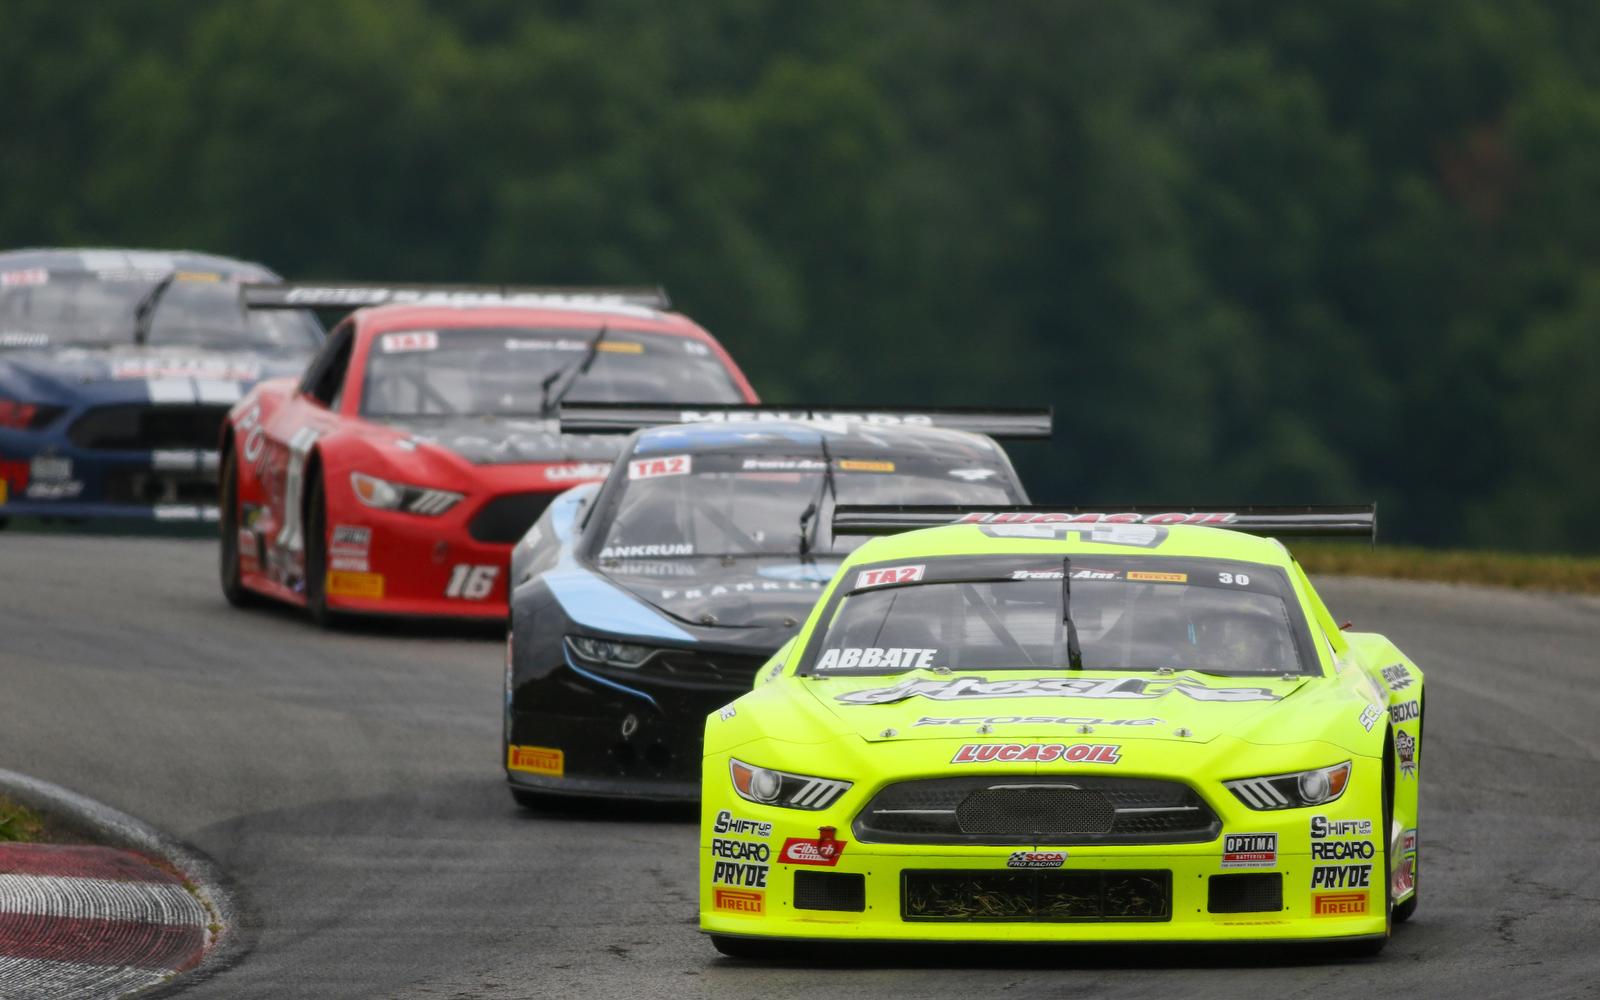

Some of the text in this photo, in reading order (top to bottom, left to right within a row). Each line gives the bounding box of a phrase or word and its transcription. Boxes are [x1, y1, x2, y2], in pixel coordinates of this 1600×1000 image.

[635, 458, 684, 476] TA2
[600, 544, 693, 558] ANKRUM
[445, 564, 499, 598] 16
[865, 566, 918, 585] TA2
[1218, 572, 1249, 586] 30
[660, 581, 820, 599] FRANKLI
[815, 647, 938, 670] ABBATE
[951, 743, 1122, 764] LUCAS OIL
[714, 811, 772, 835] SHIFT UP
[1311, 816, 1371, 838] SHIFT UP
[712, 838, 770, 862] RECARO
[1227, 837, 1274, 852] OPTIMA
[1311, 841, 1375, 860] RECARO
[1025, 853, 1064, 861] SCCA
[713, 862, 769, 887] PRYDE
[1312, 865, 1373, 888] PRYDE
[715, 889, 762, 912] PIRELLI
[1315, 894, 1366, 914] PIRELLI
